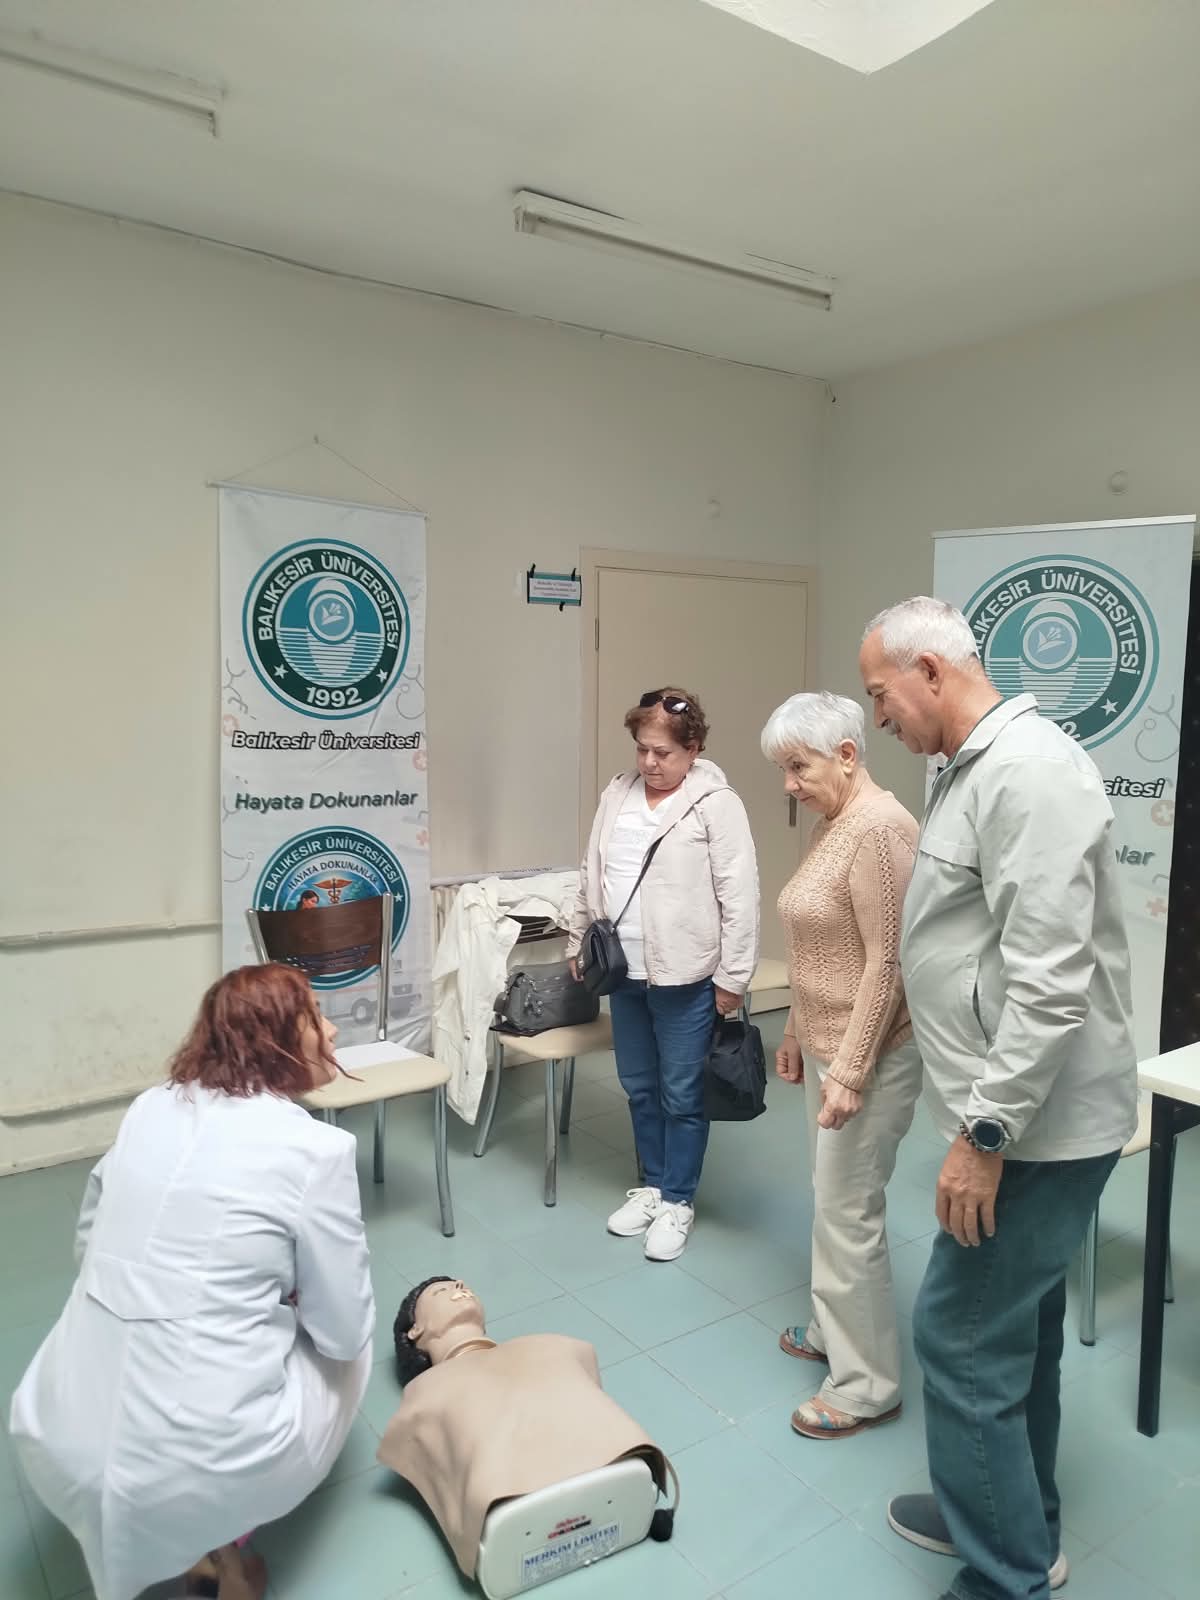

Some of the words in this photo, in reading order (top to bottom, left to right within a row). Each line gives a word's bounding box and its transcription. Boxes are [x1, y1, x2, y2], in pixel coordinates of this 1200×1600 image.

[258, 556, 314, 641] BALIKESİR
[320, 551, 400, 650] ÜNİVERSİTESİ
[974, 578, 1032, 650] LIKESİR
[1041, 569, 1141, 676] ÜNİVERSİTESİ
[306, 686, 362, 708] 1992
[318, 730, 420, 750] Üniversitesi
[1102, 776, 1166, 798] sitesi
[235, 792, 304, 814] Hayata
[309, 790, 419, 809] Dokunanlar
[265, 837, 323, 891] BALIKESİR
[325, 836, 400, 884] ÜNİVERSİTESİ
[287, 865, 320, 890] HAYATA
